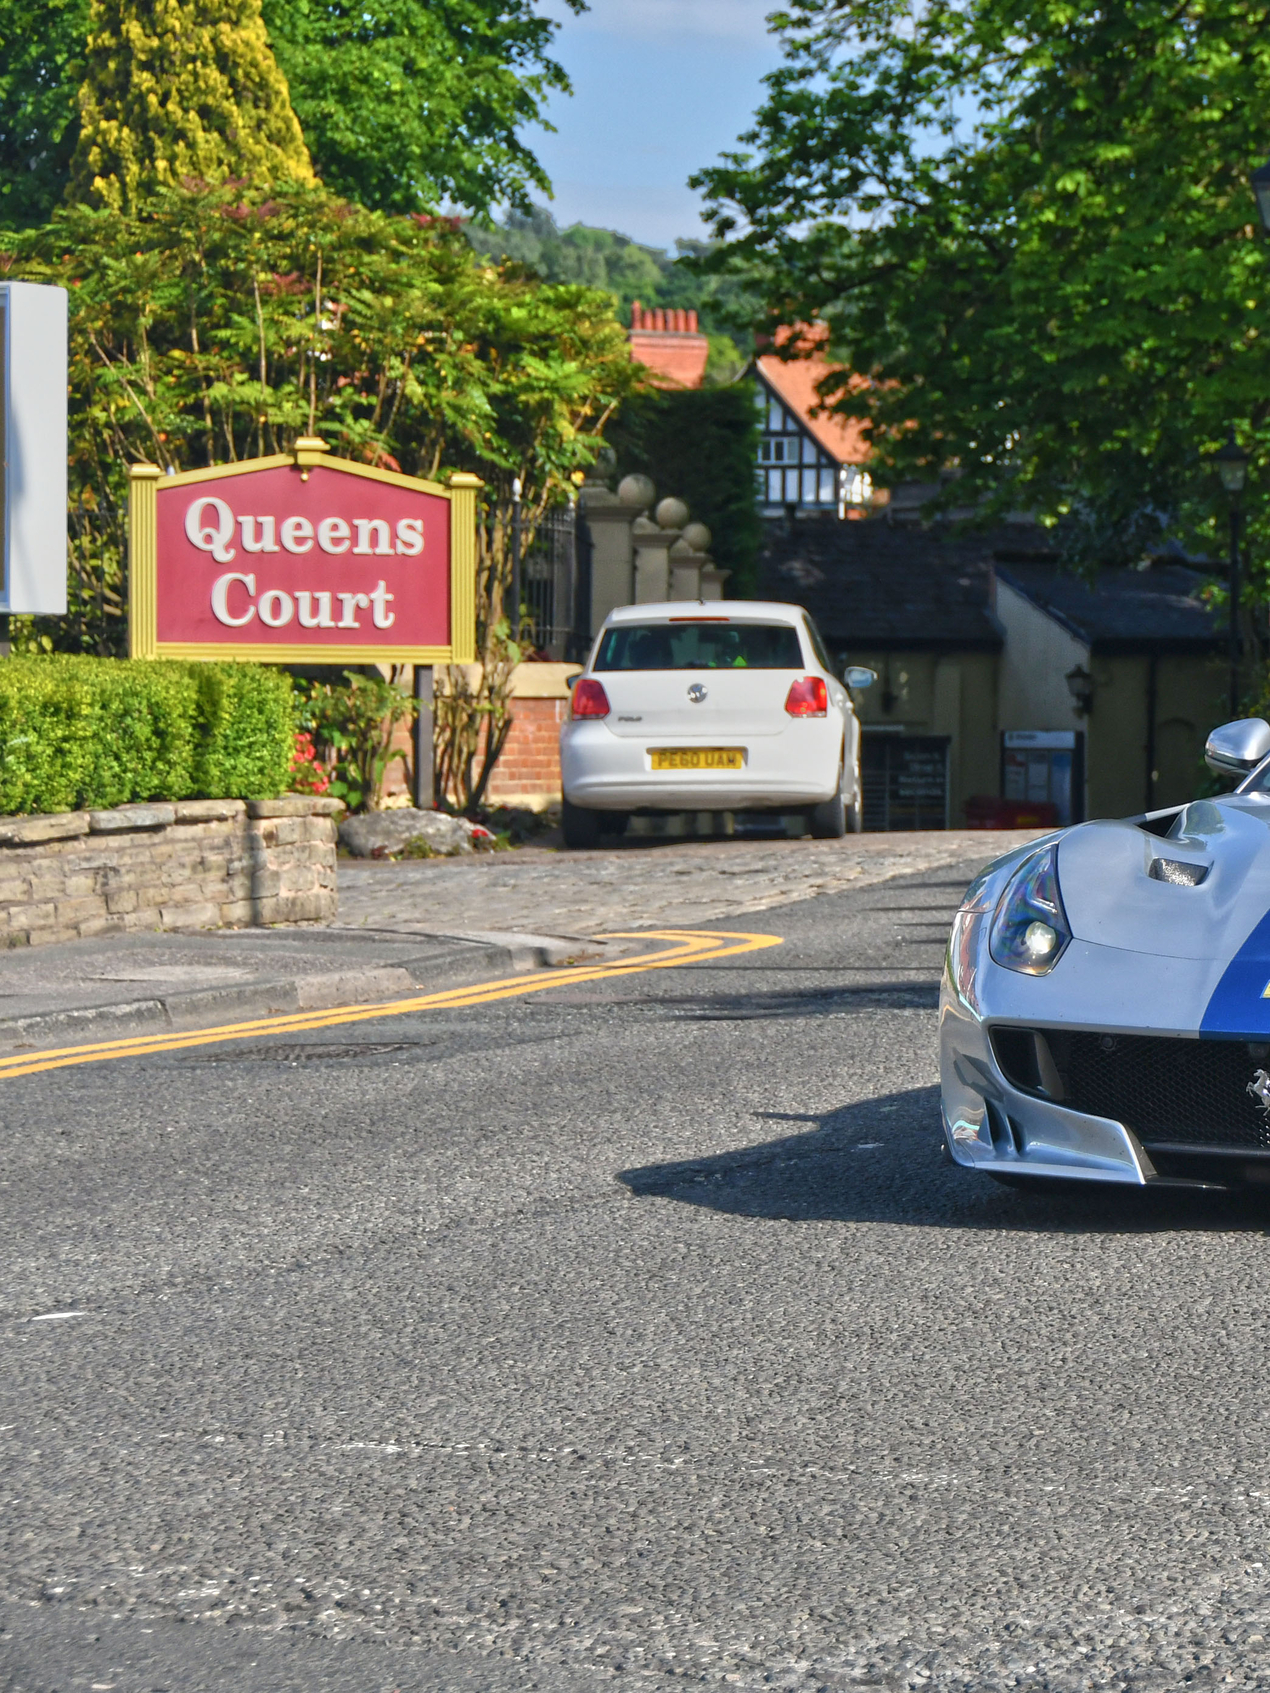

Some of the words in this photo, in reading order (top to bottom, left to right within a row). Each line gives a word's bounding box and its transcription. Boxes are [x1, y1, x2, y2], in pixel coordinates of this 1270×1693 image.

[184, 497, 424, 562] Queens
[211, 573, 395, 629] Court
[657, 752, 701, 767] PE60
